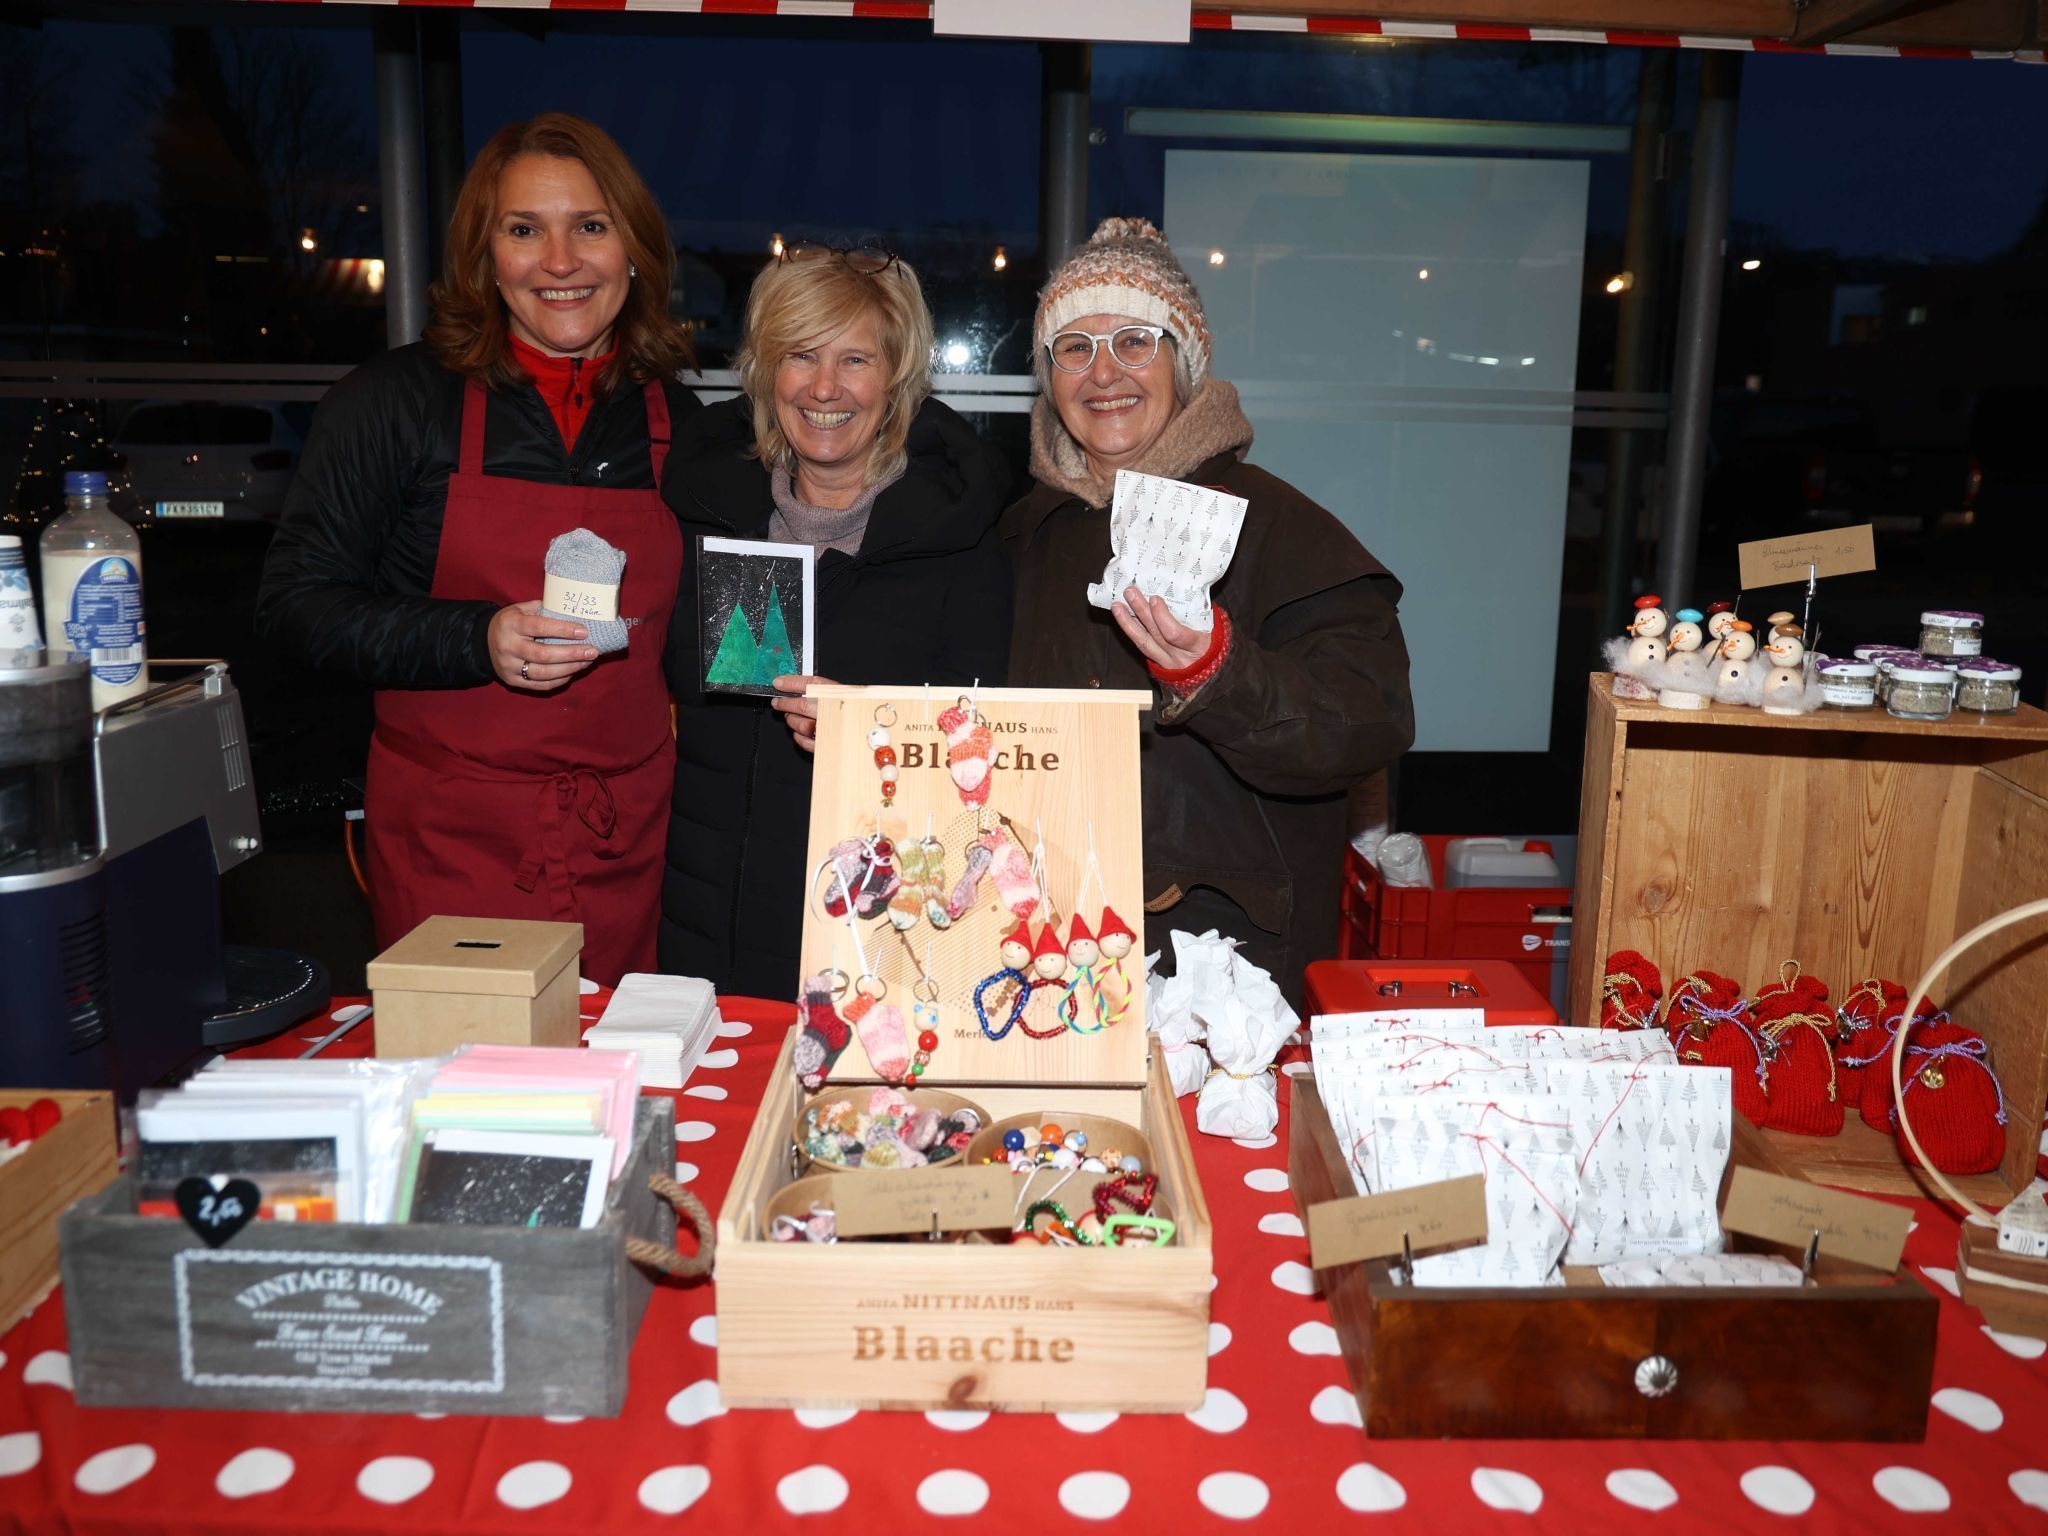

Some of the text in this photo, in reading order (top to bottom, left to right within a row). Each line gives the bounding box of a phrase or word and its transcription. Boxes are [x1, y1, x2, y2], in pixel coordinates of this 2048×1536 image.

[563, 591, 597, 608] 32/33
[904, 723, 934, 732] ANITA
[1031, 726, 1059, 734] HANS
[900, 742, 1060, 770] Blche
[234, 1268, 445, 1316] VINTAGE HOME
[902, 1294, 1031, 1311] NITTNAUS
[853, 1325, 1076, 1363] Blaache
[352, 1352, 392, 1366] Market
